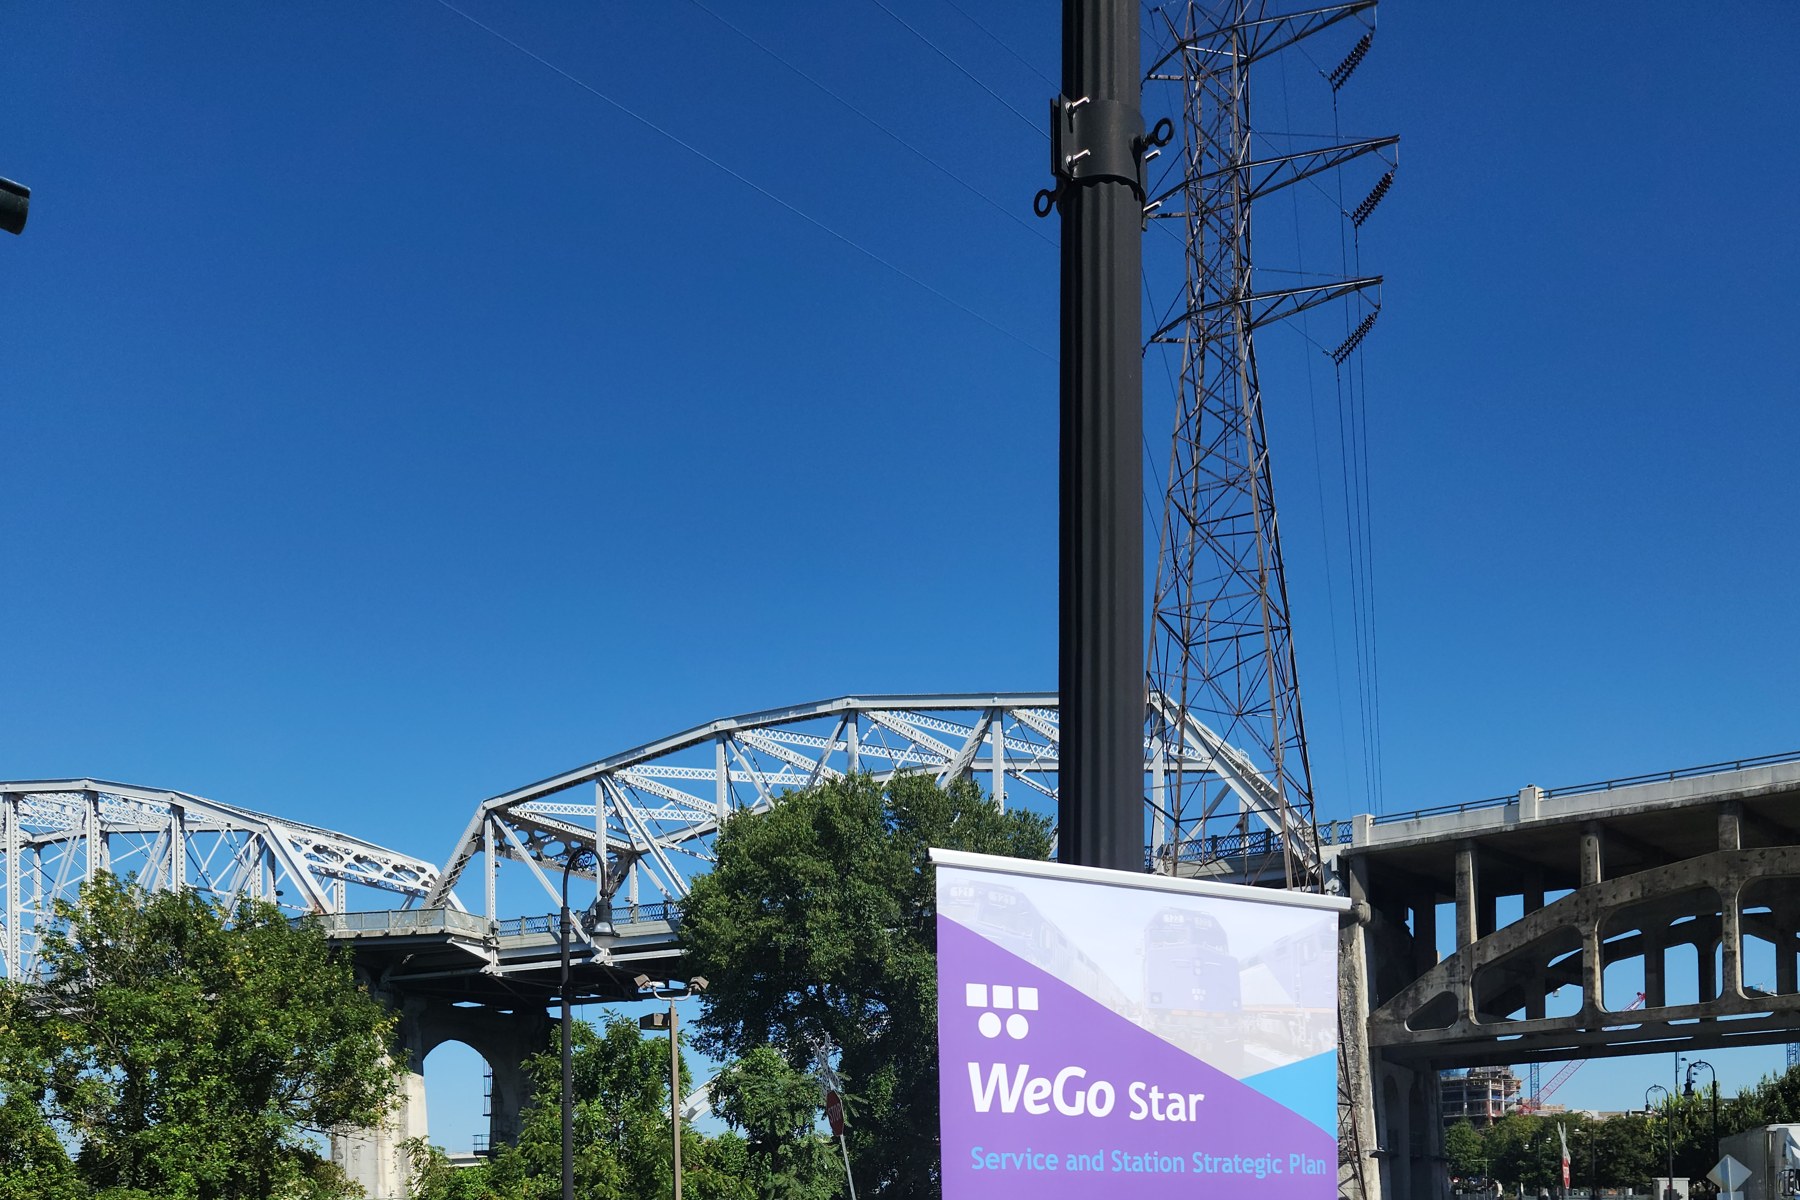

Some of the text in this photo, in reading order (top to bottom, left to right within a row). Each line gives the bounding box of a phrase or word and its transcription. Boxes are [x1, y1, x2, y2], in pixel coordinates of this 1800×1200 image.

[967, 1062, 1205, 1122] WeGo Star
[971, 1146, 1326, 1180] Service and Station Strategic Plan
